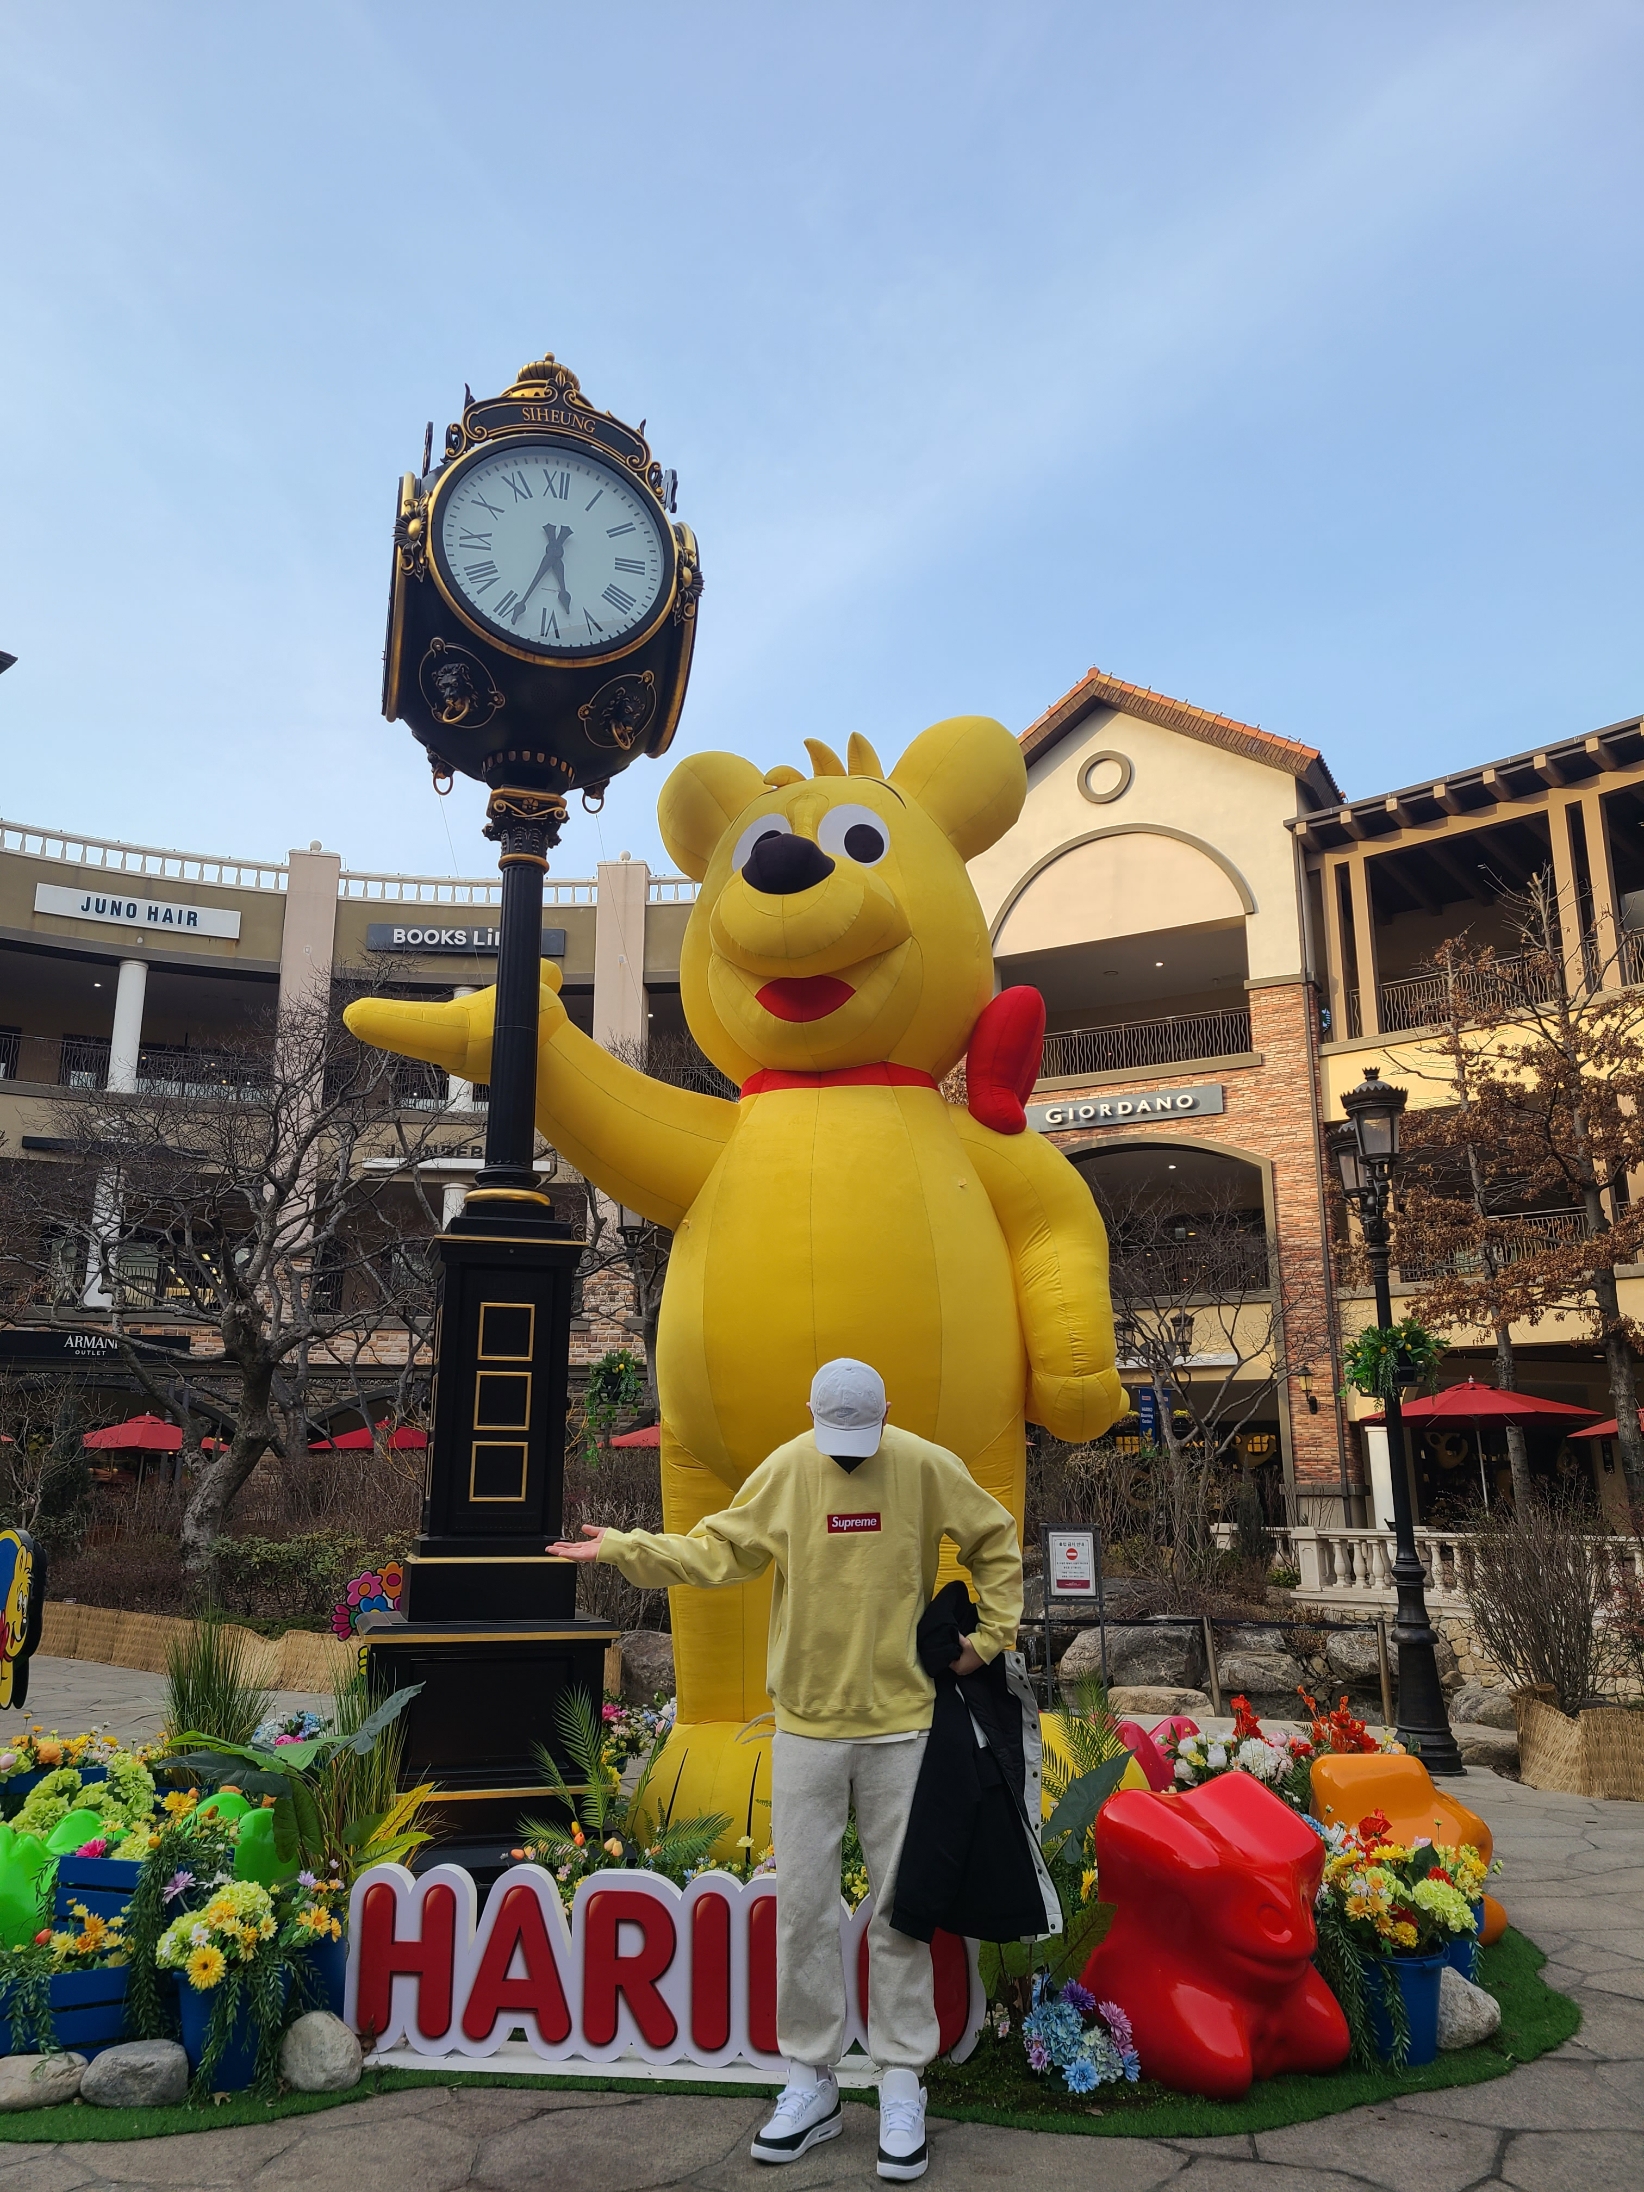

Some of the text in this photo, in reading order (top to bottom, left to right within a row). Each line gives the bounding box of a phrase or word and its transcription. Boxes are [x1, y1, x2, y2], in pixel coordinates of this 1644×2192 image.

[522, 407, 596, 434] SIHEUNG
[500, 470, 533, 503] XI
[542, 468, 571, 501] XII
[80, 896, 199, 927] JUNO HAIR
[392, 928, 467, 945] BOOKS
[1045, 1094, 1194, 1124] GIORDANO
[64, 1335, 118, 1349] ARMANI
[831, 1516, 877, 1531] Supreme
